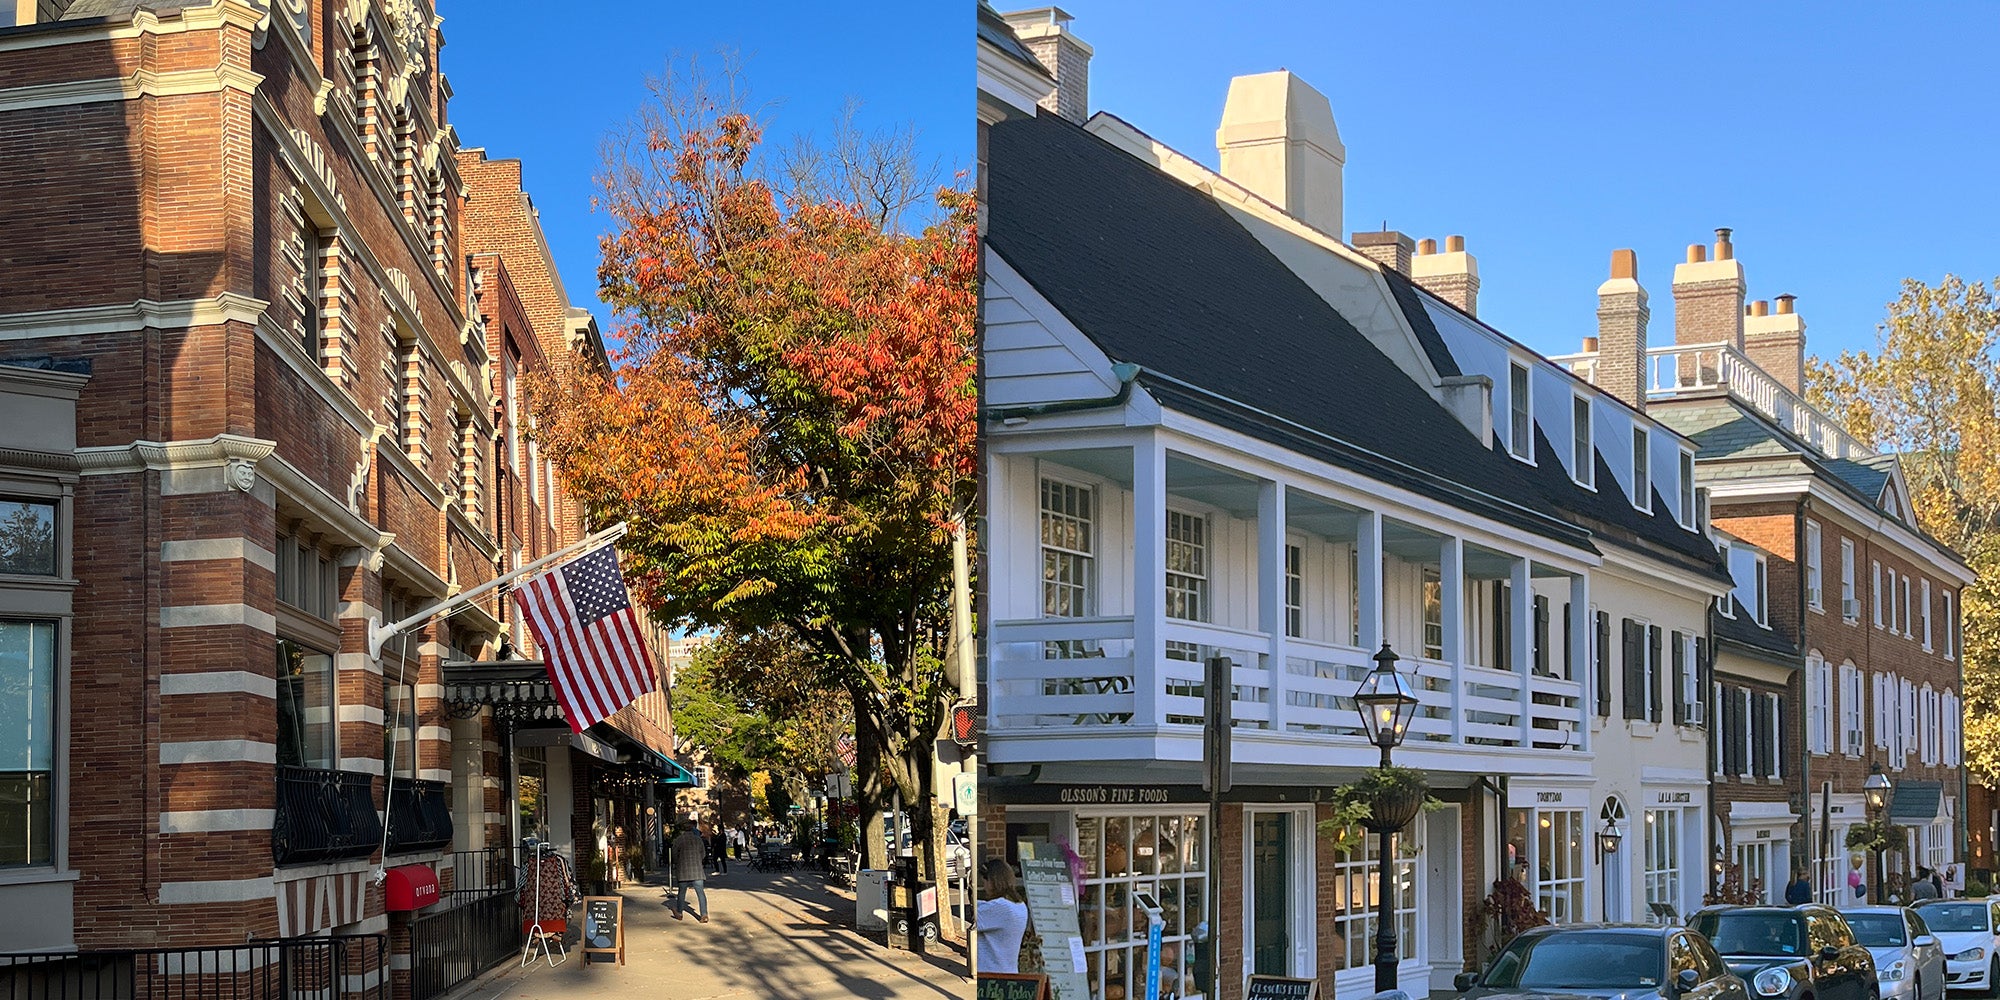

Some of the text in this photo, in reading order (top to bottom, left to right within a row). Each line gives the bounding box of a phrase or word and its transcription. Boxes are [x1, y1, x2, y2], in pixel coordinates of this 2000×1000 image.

[1060, 786, 1168, 802] OLSSON'S FINE FOODS
